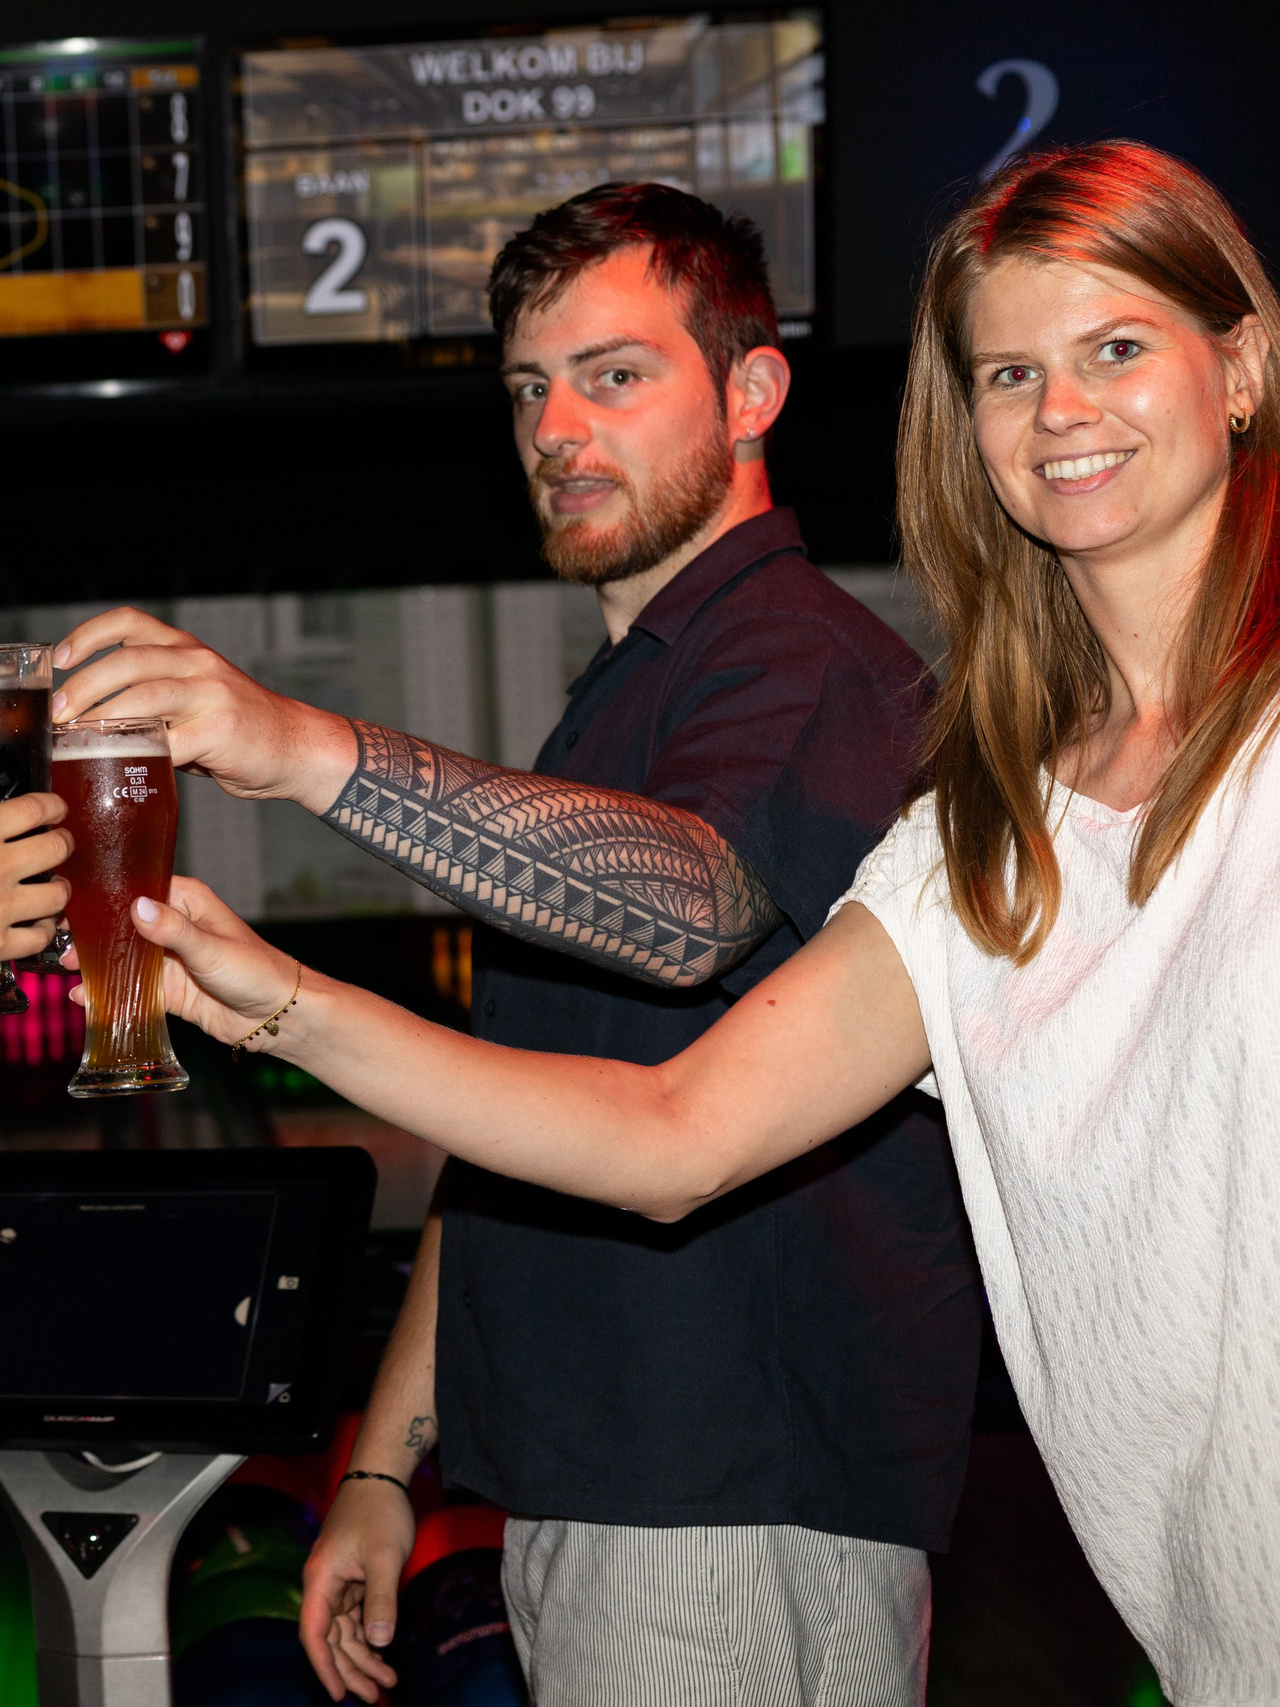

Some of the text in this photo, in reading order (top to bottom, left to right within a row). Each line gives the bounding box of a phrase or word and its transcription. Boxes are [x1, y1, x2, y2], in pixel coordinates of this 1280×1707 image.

[410, 40, 646, 86] WELKOM BIJ
[462, 84, 596, 124] DOK 99
[302, 216, 368, 317] 2
